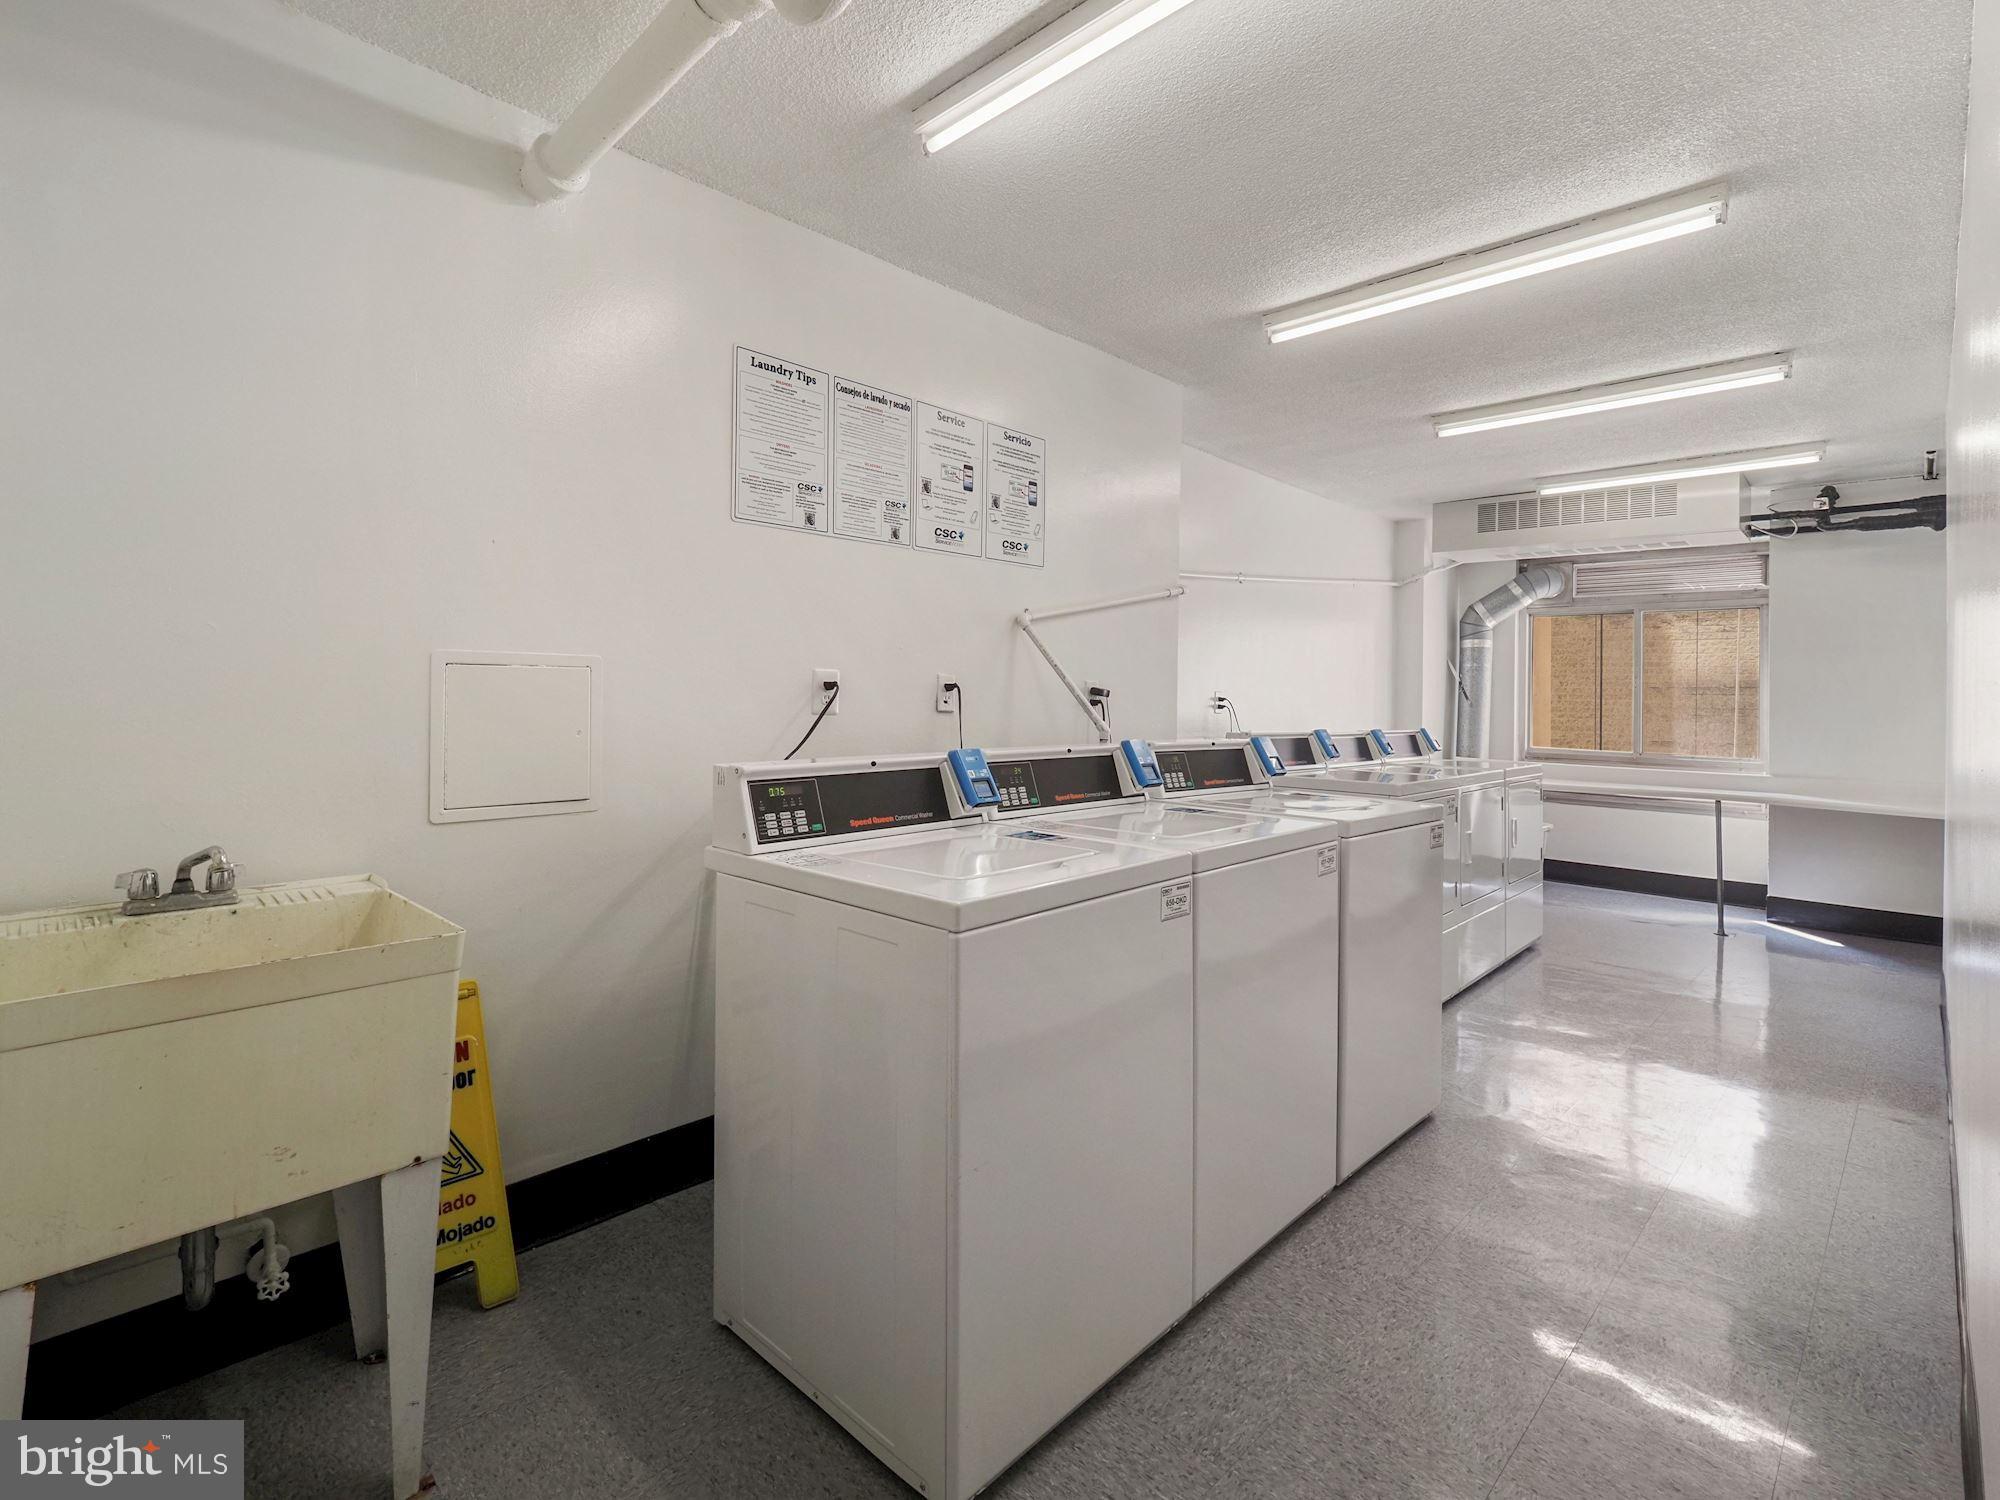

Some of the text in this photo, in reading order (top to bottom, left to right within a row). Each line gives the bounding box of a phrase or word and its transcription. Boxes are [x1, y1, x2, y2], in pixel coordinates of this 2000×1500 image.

[750, 356, 817, 386] Laundry Tips
[836, 382, 862, 399] Consejos
[862, 390, 870, 400] de
[870, 391, 889, 406] lavado
[889, 400, 893, 409] y
[893, 401, 911, 412] secado
[937, 410, 966, 428] Service
[1003, 431, 1032, 447] Servicio
[797, 482, 817, 492] CSC
[885, 500, 902, 509] CSC
[934, 527, 958, 539] CSC
[1002, 540, 1023, 551] CSC
[850, 817, 872, 827] Speed
[872, 815, 895, 824] Queen
